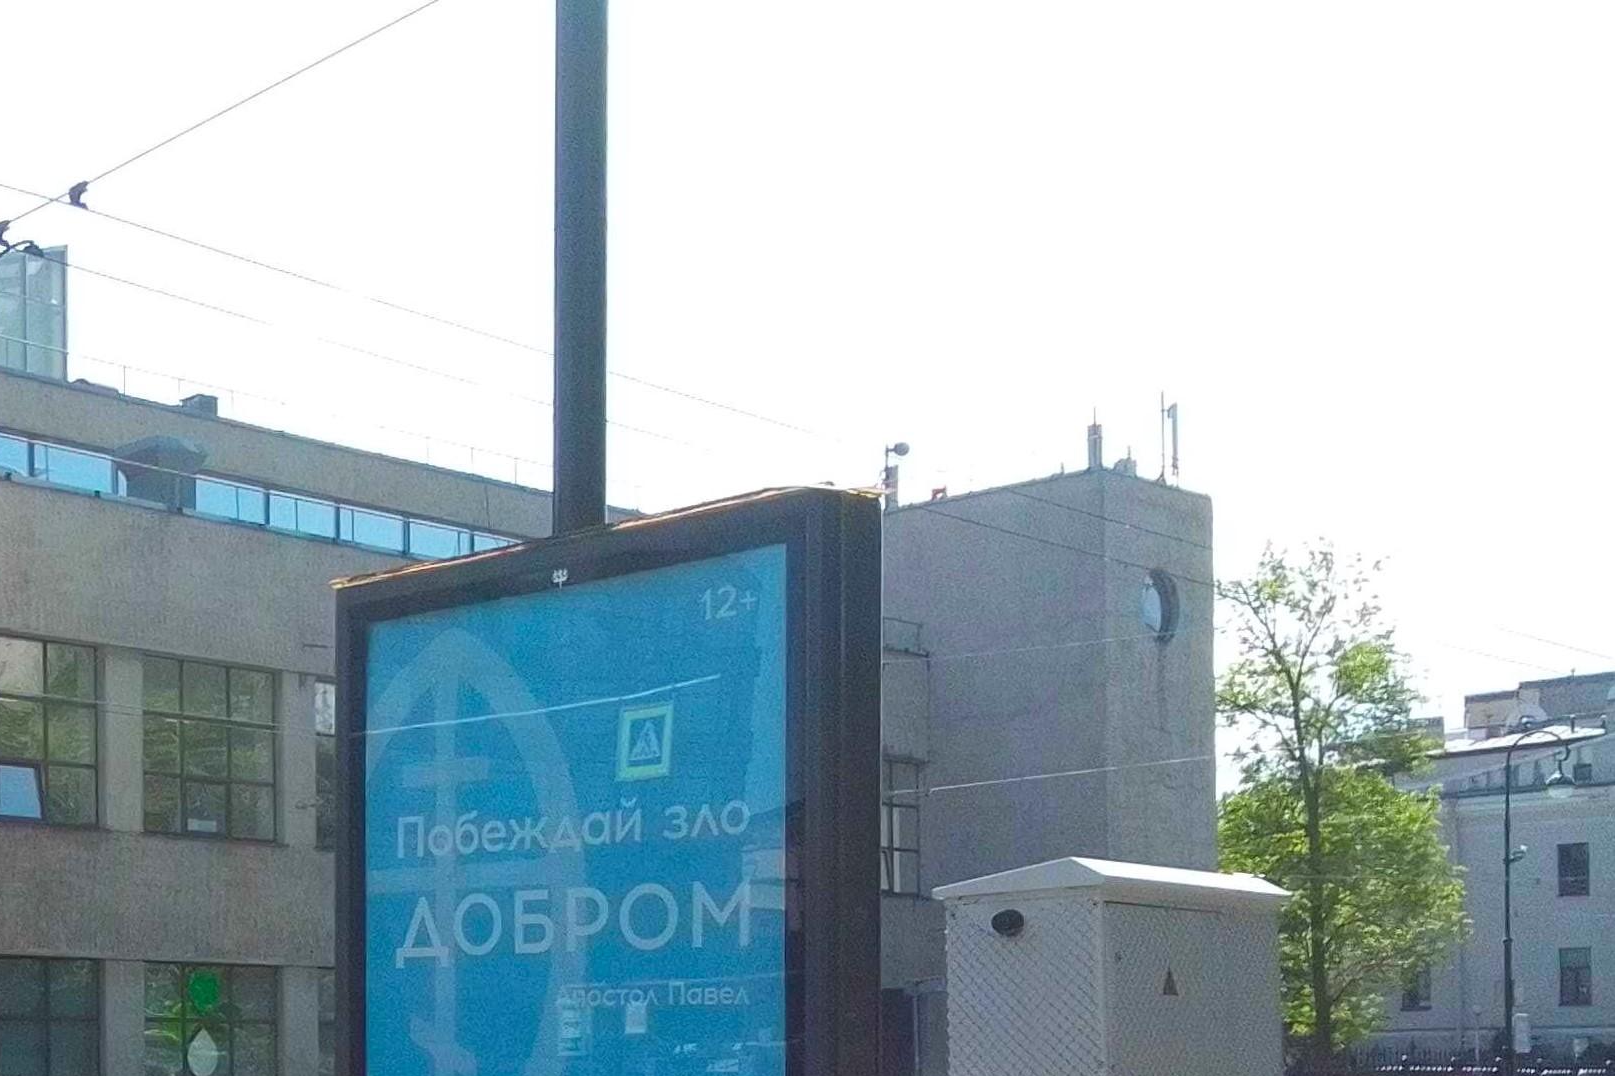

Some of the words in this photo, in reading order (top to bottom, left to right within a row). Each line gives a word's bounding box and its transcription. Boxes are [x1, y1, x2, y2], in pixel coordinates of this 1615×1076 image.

[697, 585, 758, 620] 12+
[396, 795, 643, 859] Побеждай
[662, 800, 752, 840] зло
[395, 881, 753, 970] ДОБРОМ
[669, 981, 751, 1006] Павел
